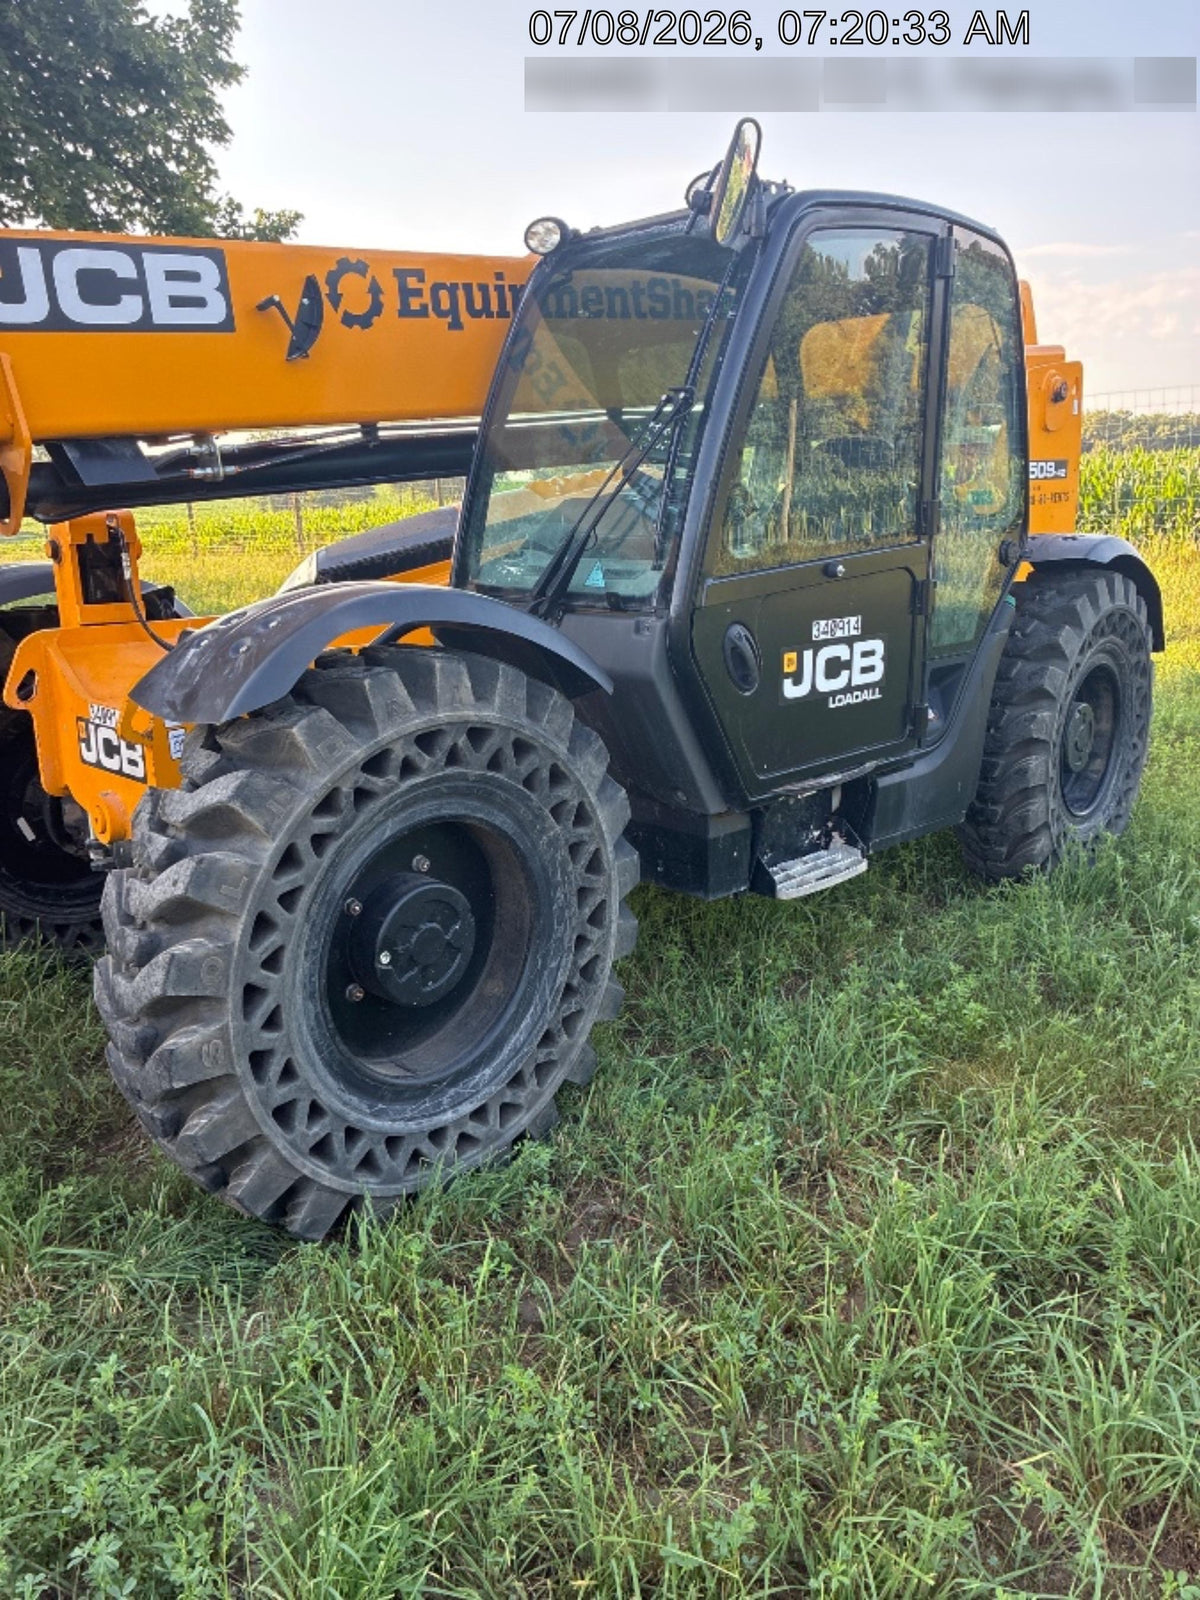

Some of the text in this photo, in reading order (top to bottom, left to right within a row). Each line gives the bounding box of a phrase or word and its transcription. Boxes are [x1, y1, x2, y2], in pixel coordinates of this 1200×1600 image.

[0, 246, 227, 325] JCB
[783, 639, 885, 699] JCB
[828, 688, 882, 708] LOADALL
[80, 720, 145, 778] JCB
